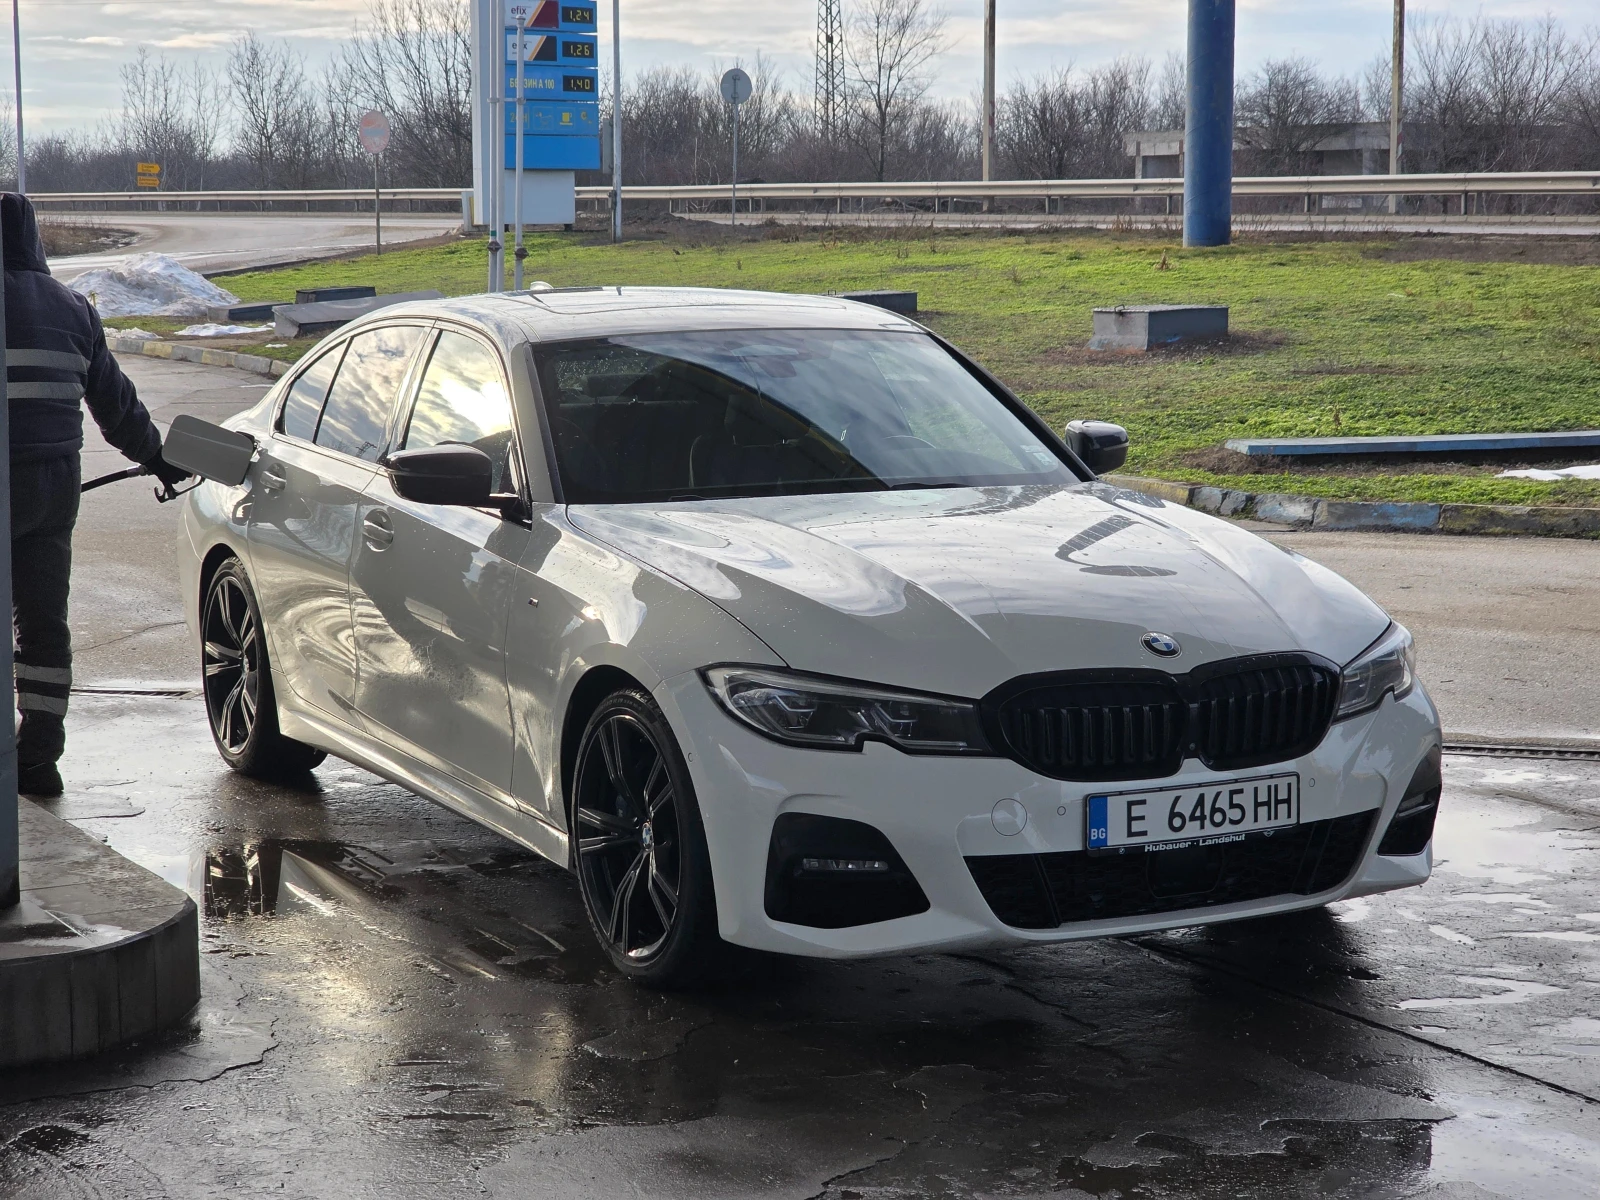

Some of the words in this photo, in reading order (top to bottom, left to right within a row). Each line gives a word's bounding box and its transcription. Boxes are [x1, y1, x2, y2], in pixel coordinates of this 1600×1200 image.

[511, 5, 527, 15] efix
[569, 10, 590, 22] 1,24
[511, 41, 528, 50] ex
[570, 44, 590, 56] 1,26
[509, 78, 538, 89] БЕЗИН
[545, 79, 555, 89] 100
[570, 79, 591, 90] 1,40
[1126, 799, 1148, 838] E
[1167, 788, 1246, 833] 6465
[1253, 782, 1292, 823] HH
[1090, 827, 1106, 840] BG
[1144, 840, 1192, 853] Hubauer
[1199, 833, 1246, 847] Landshut
